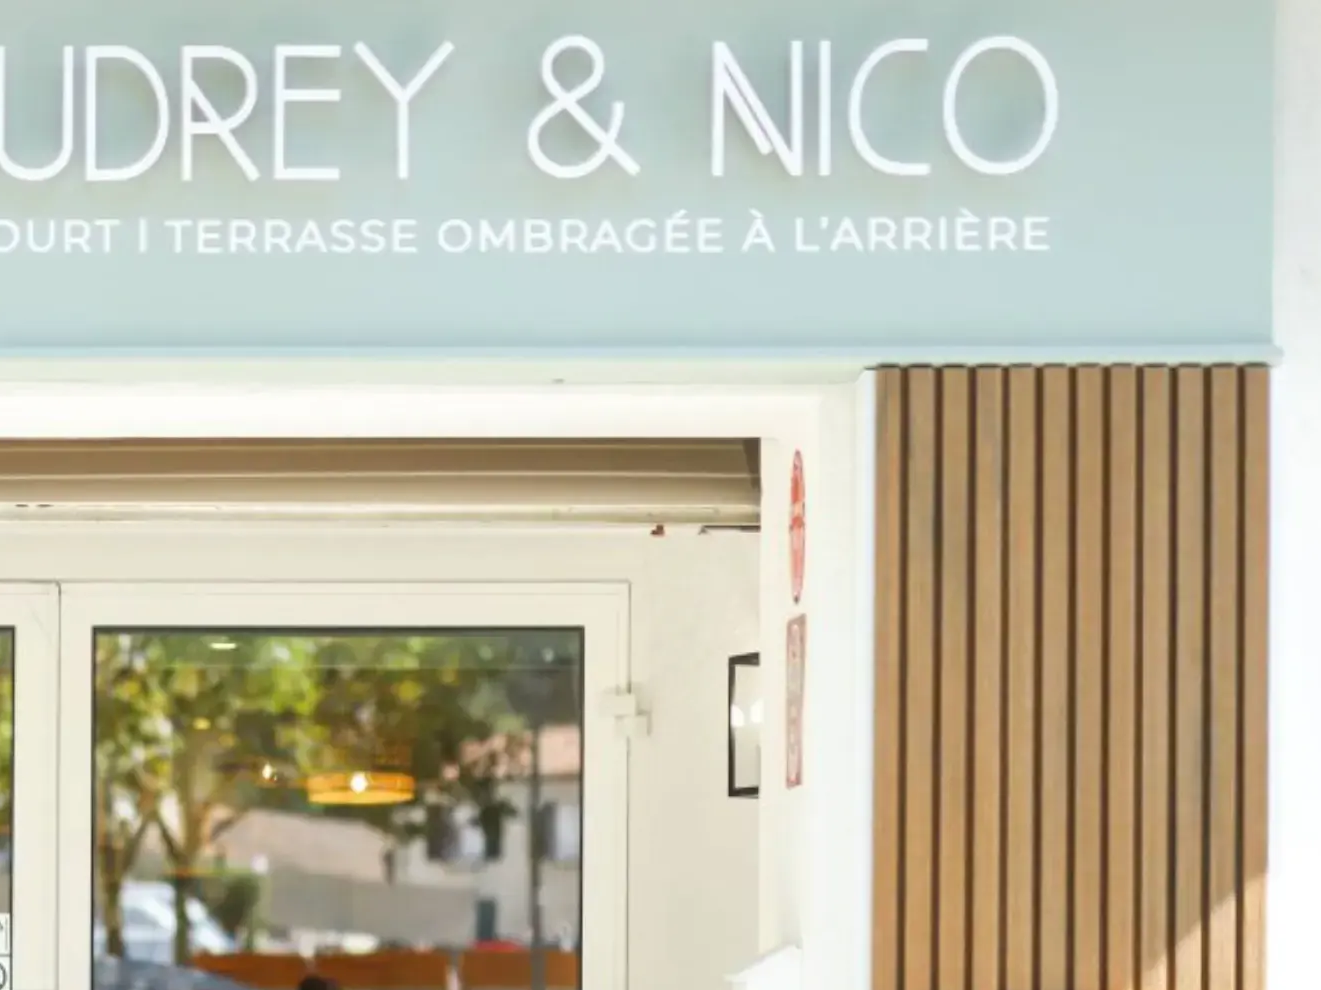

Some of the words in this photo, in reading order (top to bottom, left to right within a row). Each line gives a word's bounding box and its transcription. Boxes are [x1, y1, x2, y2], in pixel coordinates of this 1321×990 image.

[527, 35, 641, 179] &
[711, 35, 1059, 177] NICO
[164, 219, 417, 254] TERRASSE
[438, 209, 723, 253] OMBRAGÉE
[741, 209, 775, 252] À
[795, 209, 1050, 252] L'ARRIÈRE
